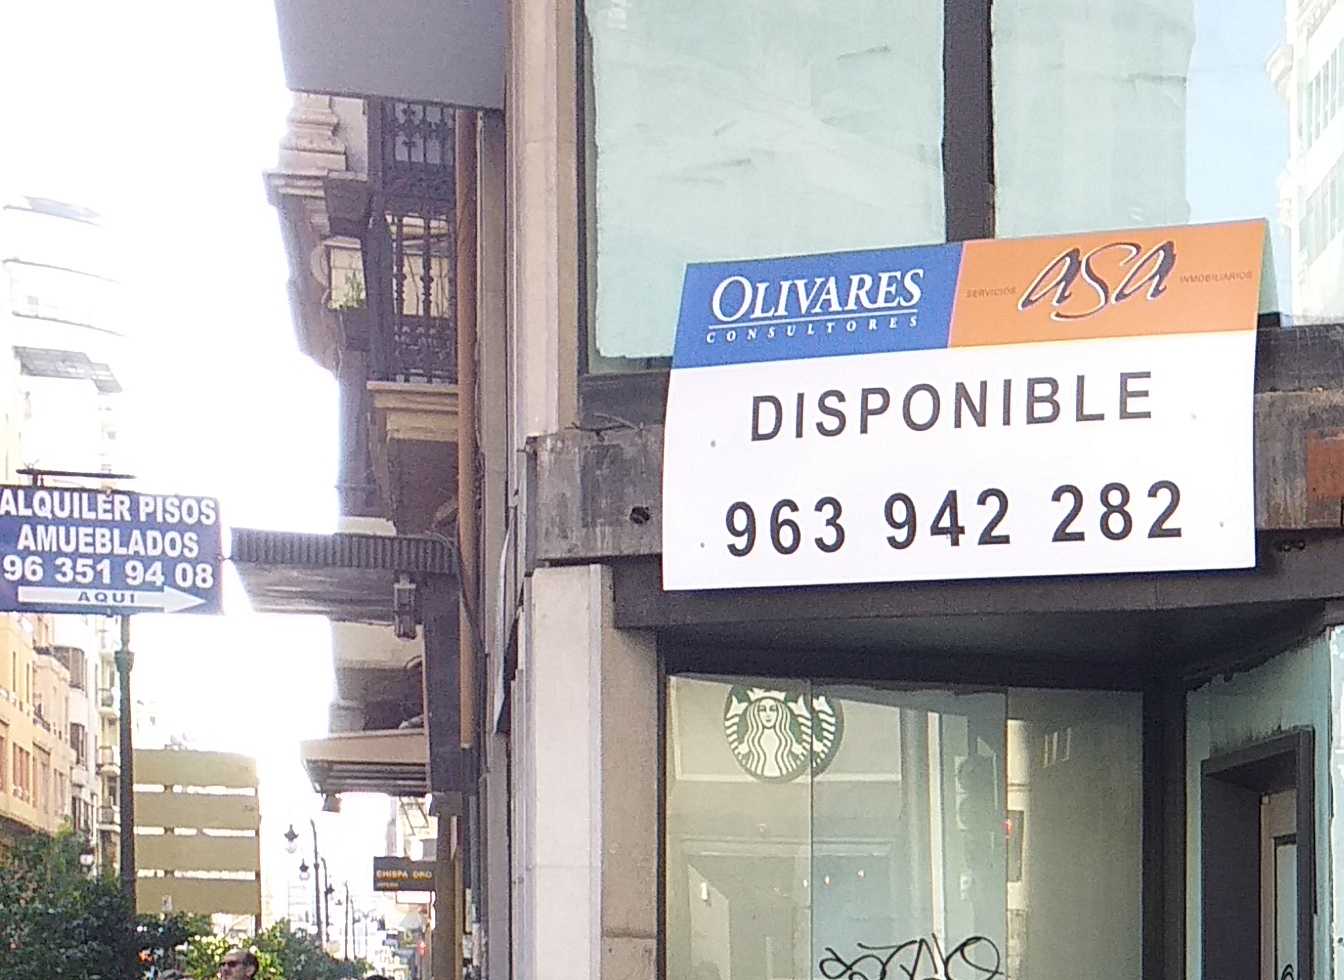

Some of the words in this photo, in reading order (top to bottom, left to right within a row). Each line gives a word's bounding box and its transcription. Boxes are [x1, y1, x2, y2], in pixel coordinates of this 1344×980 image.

[712, 268, 925, 323] OLIVARES
[965, 285, 1017, 299] SERVICIOS
[1179, 270, 1254, 284] INMOBILIARIOS
[706, 315, 918, 344] CONSULTORES
[750, 371, 1152, 442] DISPONIBLE
[0, 489, 131, 522] ALQUILER
[139, 495, 216, 525] PISOS
[725, 496, 846, 558] 963
[884, 488, 1011, 551] 942
[1051, 480, 1183, 543] 282
[17, 524, 200, 558] AMUEBLADOS
[3, 554, 44, 582] 96
[54, 556, 111, 585] 351
[125, 559, 165, 586] 94
[175, 562, 214, 589] 08
[78, 590, 136, 604] AQUI
